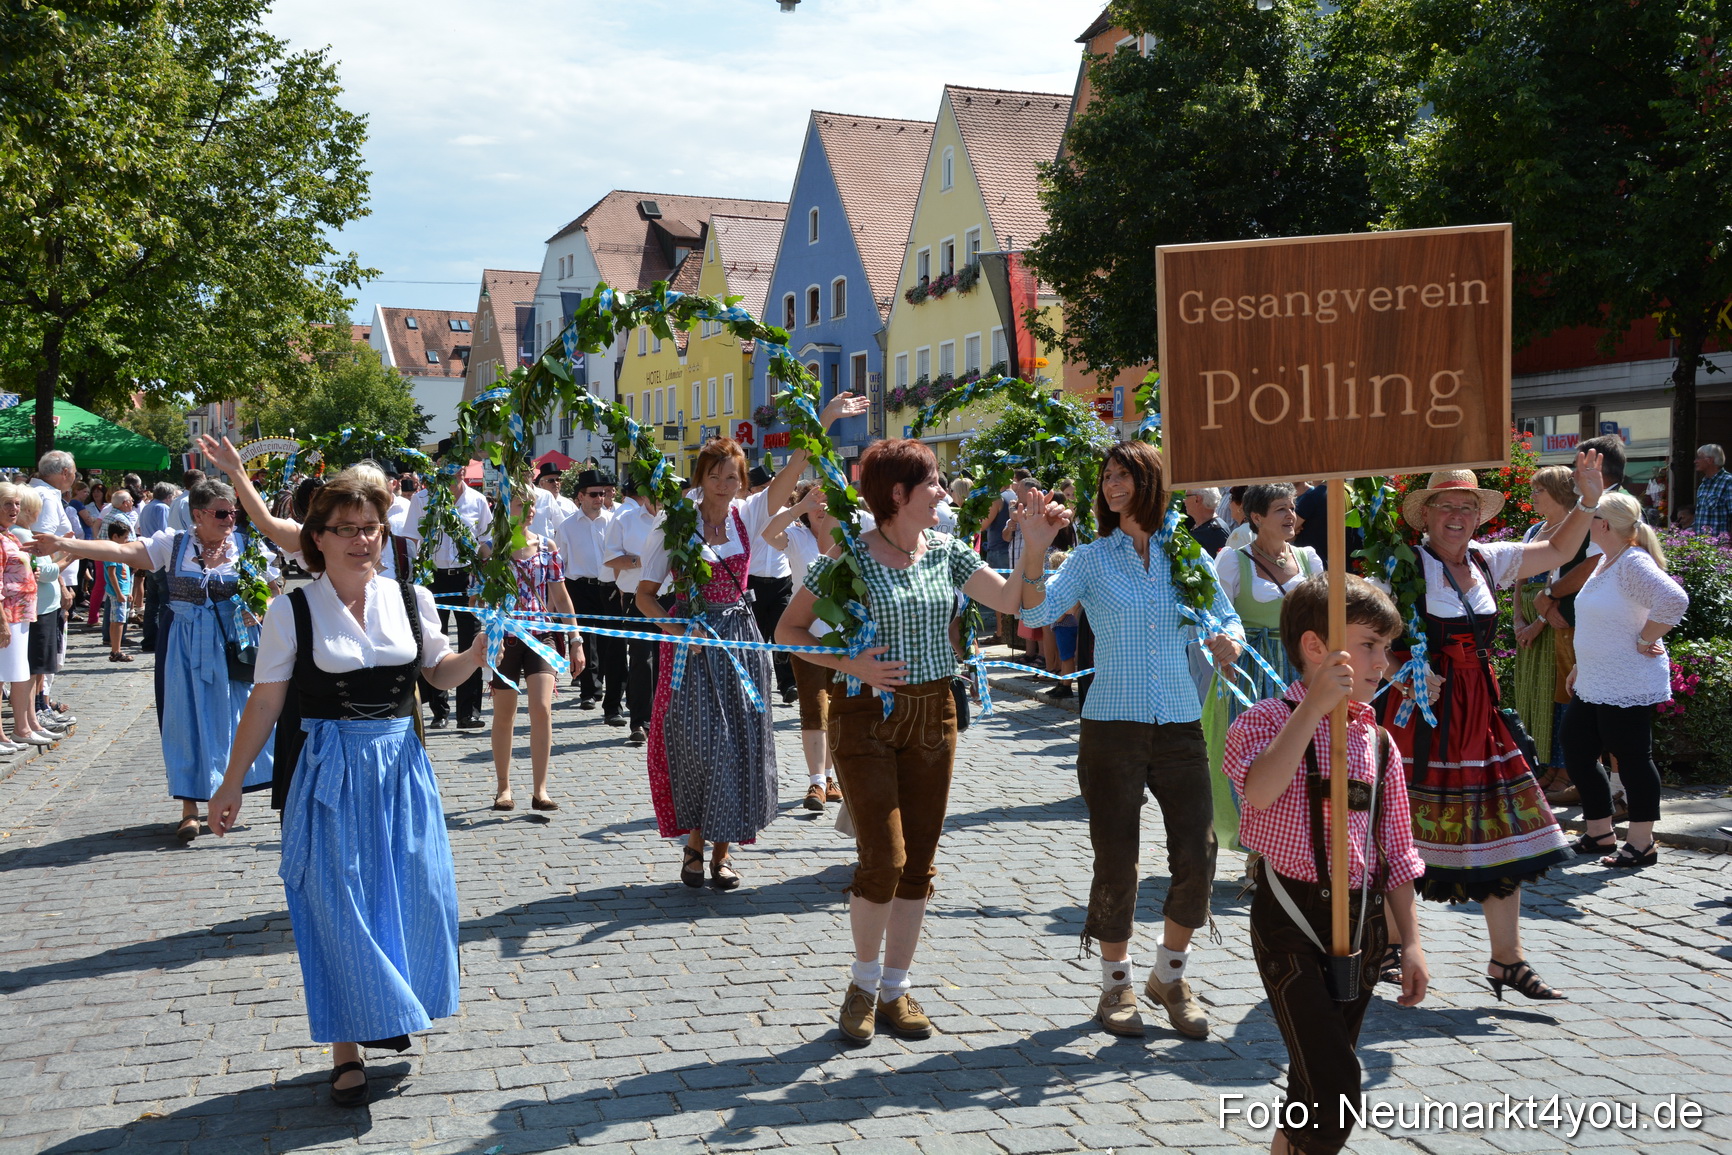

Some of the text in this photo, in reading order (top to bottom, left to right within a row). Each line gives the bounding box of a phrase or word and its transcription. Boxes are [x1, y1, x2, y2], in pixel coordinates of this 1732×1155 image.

[1178, 272, 1490, 324] Gesangverein
[646, 370, 662, 385] HOTEL
[1198, 361, 1465, 430] Pölling
[1115, 390, 1122, 414] P
